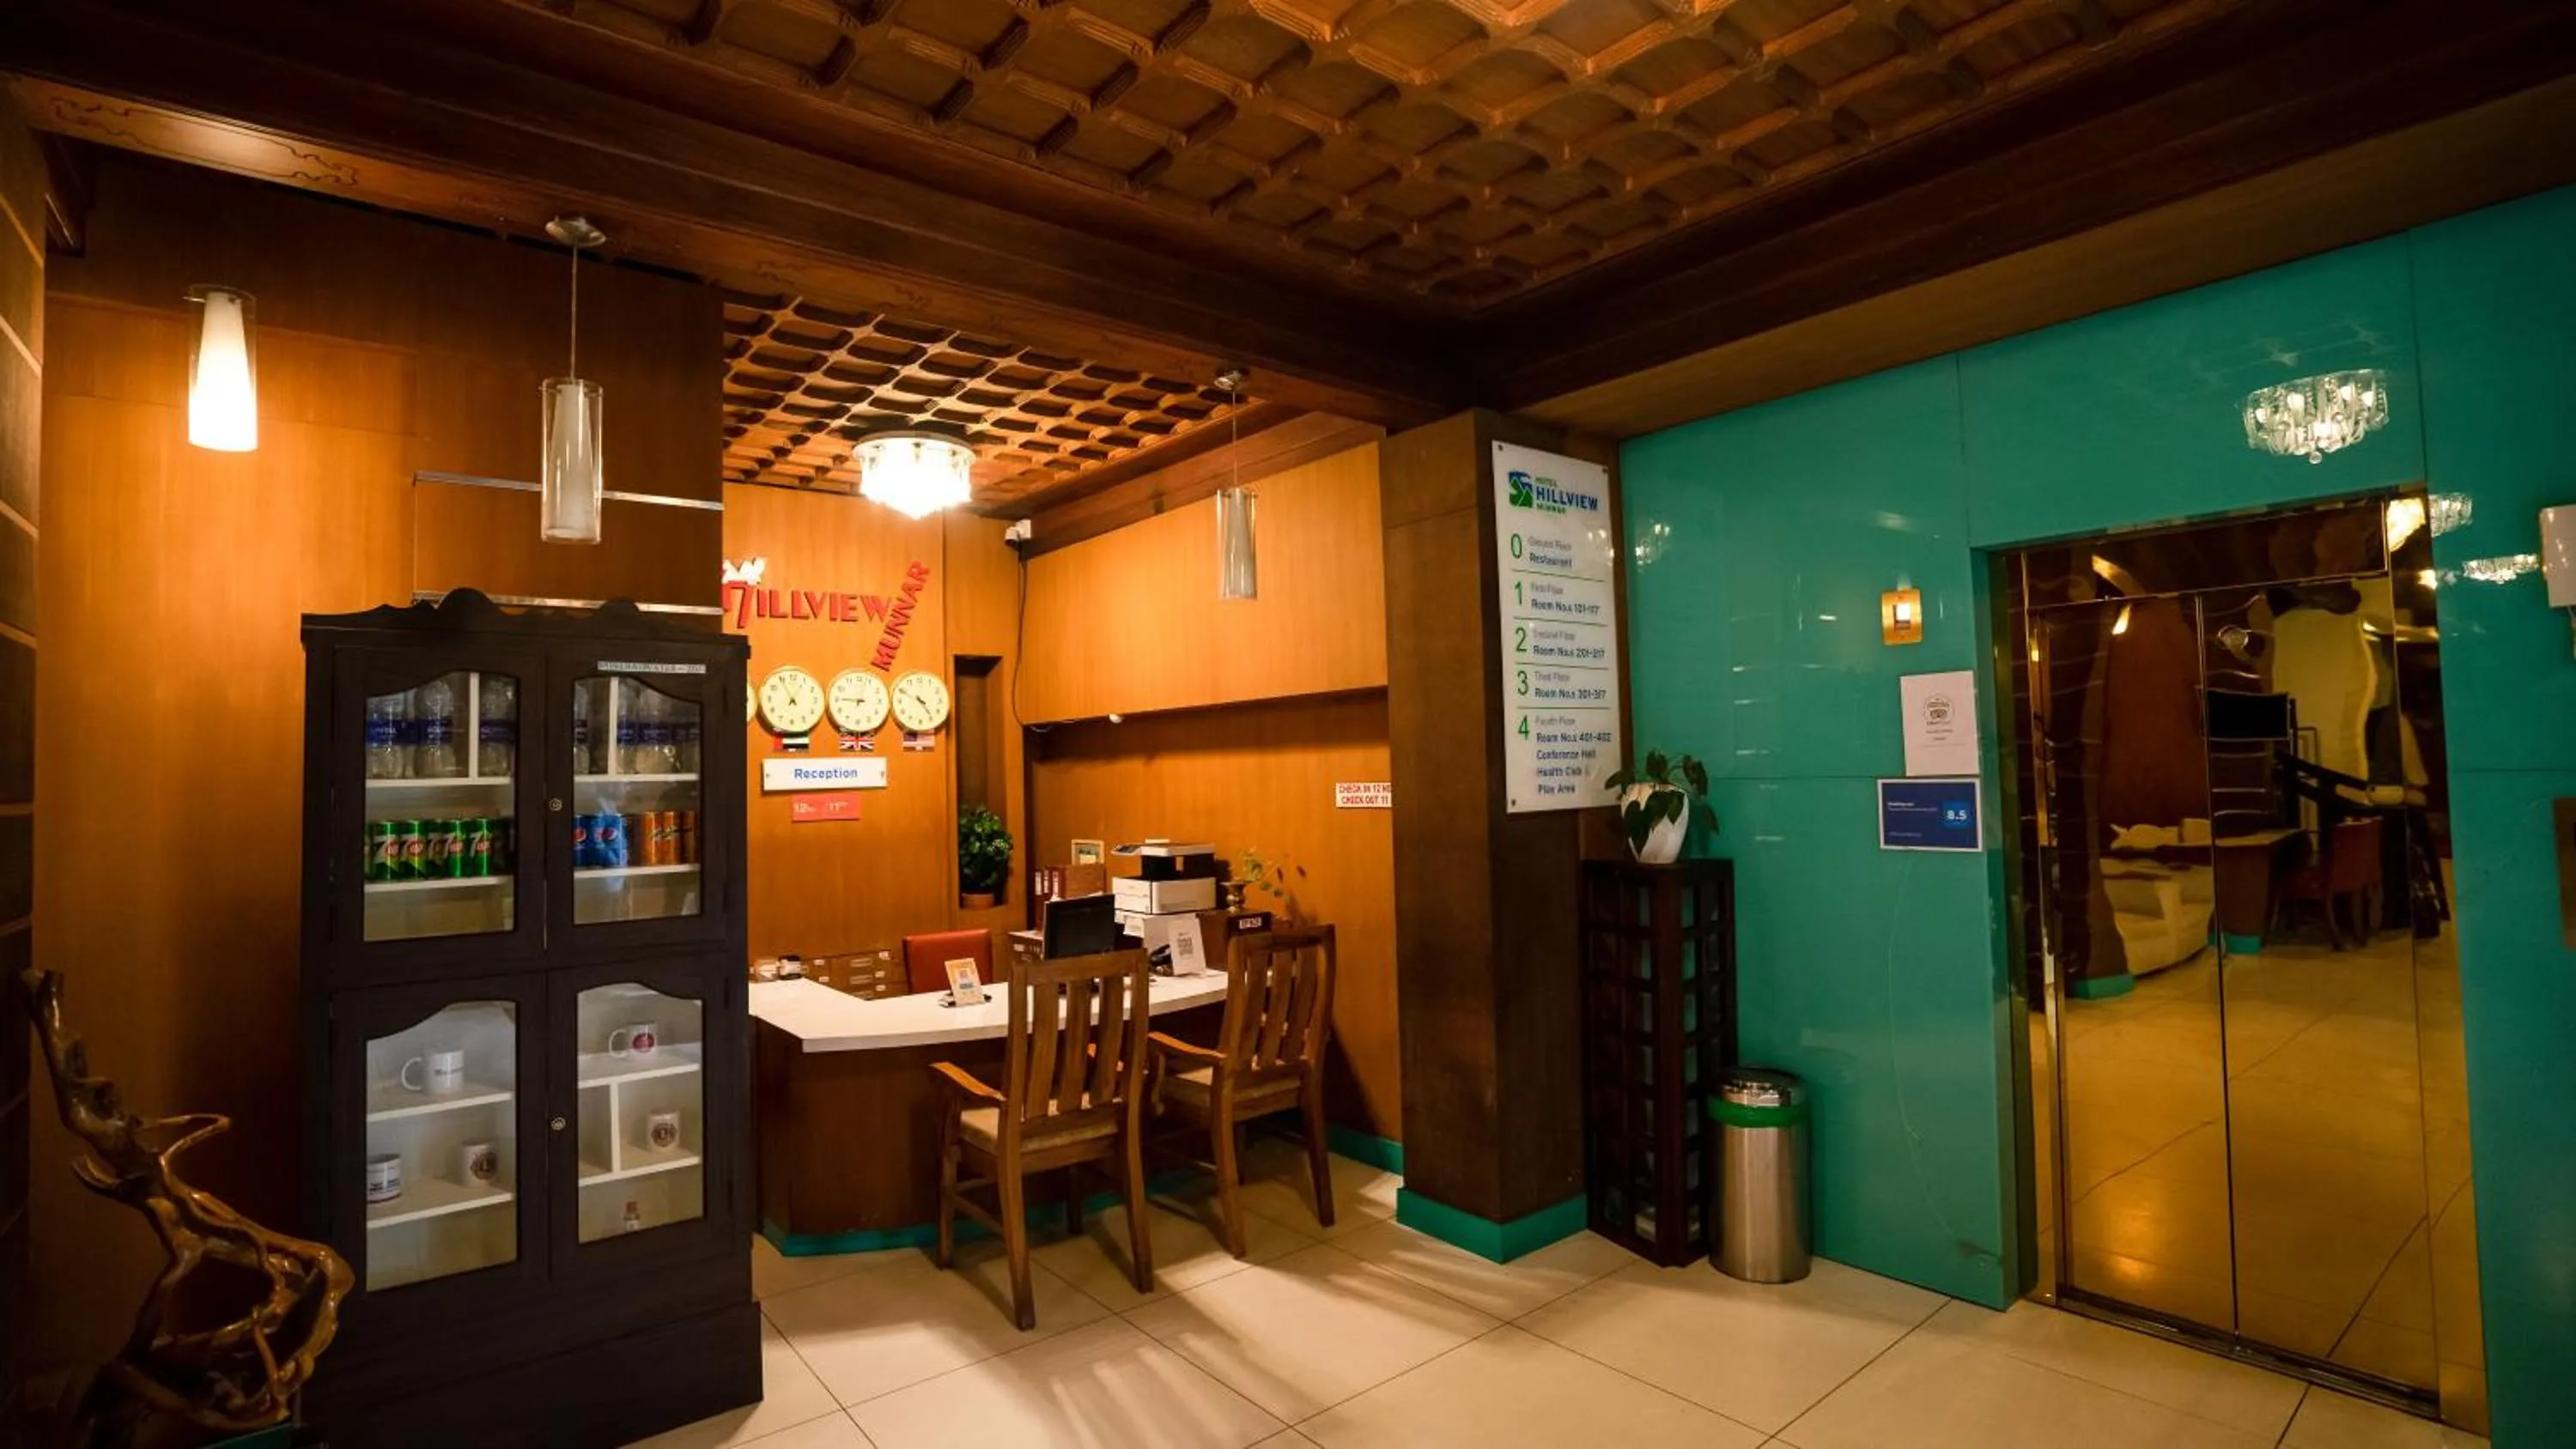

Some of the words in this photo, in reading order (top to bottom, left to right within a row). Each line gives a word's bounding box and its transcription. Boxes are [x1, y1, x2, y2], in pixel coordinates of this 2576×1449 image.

[1536, 487, 1598, 511] HILLVIEW
[1511, 533, 1522, 559] 0
[1529, 552, 1572, 568] Restaurant
[1514, 581, 1522, 605] 1
[1531, 598, 1554, 610] Room
[870, 560, 931, 672] MUNNAR
[1516, 627, 1527, 652] 2
[1533, 646, 1555, 657] Room
[1518, 670, 1528, 695] 3
[1534, 688, 1558, 698] Room
[1518, 715, 1529, 740] 4
[1536, 733, 1558, 743] Room
[1536, 749, 1579, 760] Conference
[1582, 749, 1596, 759] Hall
[794, 767, 858, 779] Reception
[1537, 767, 1563, 777] Health
[1564, 767, 1583, 777] Club
[1537, 785, 1555, 794] Play
[1557, 785, 1576, 794] Area
[1341, 796, 1364, 804] CHECK
[1947, 809, 1967, 820] 8.5
